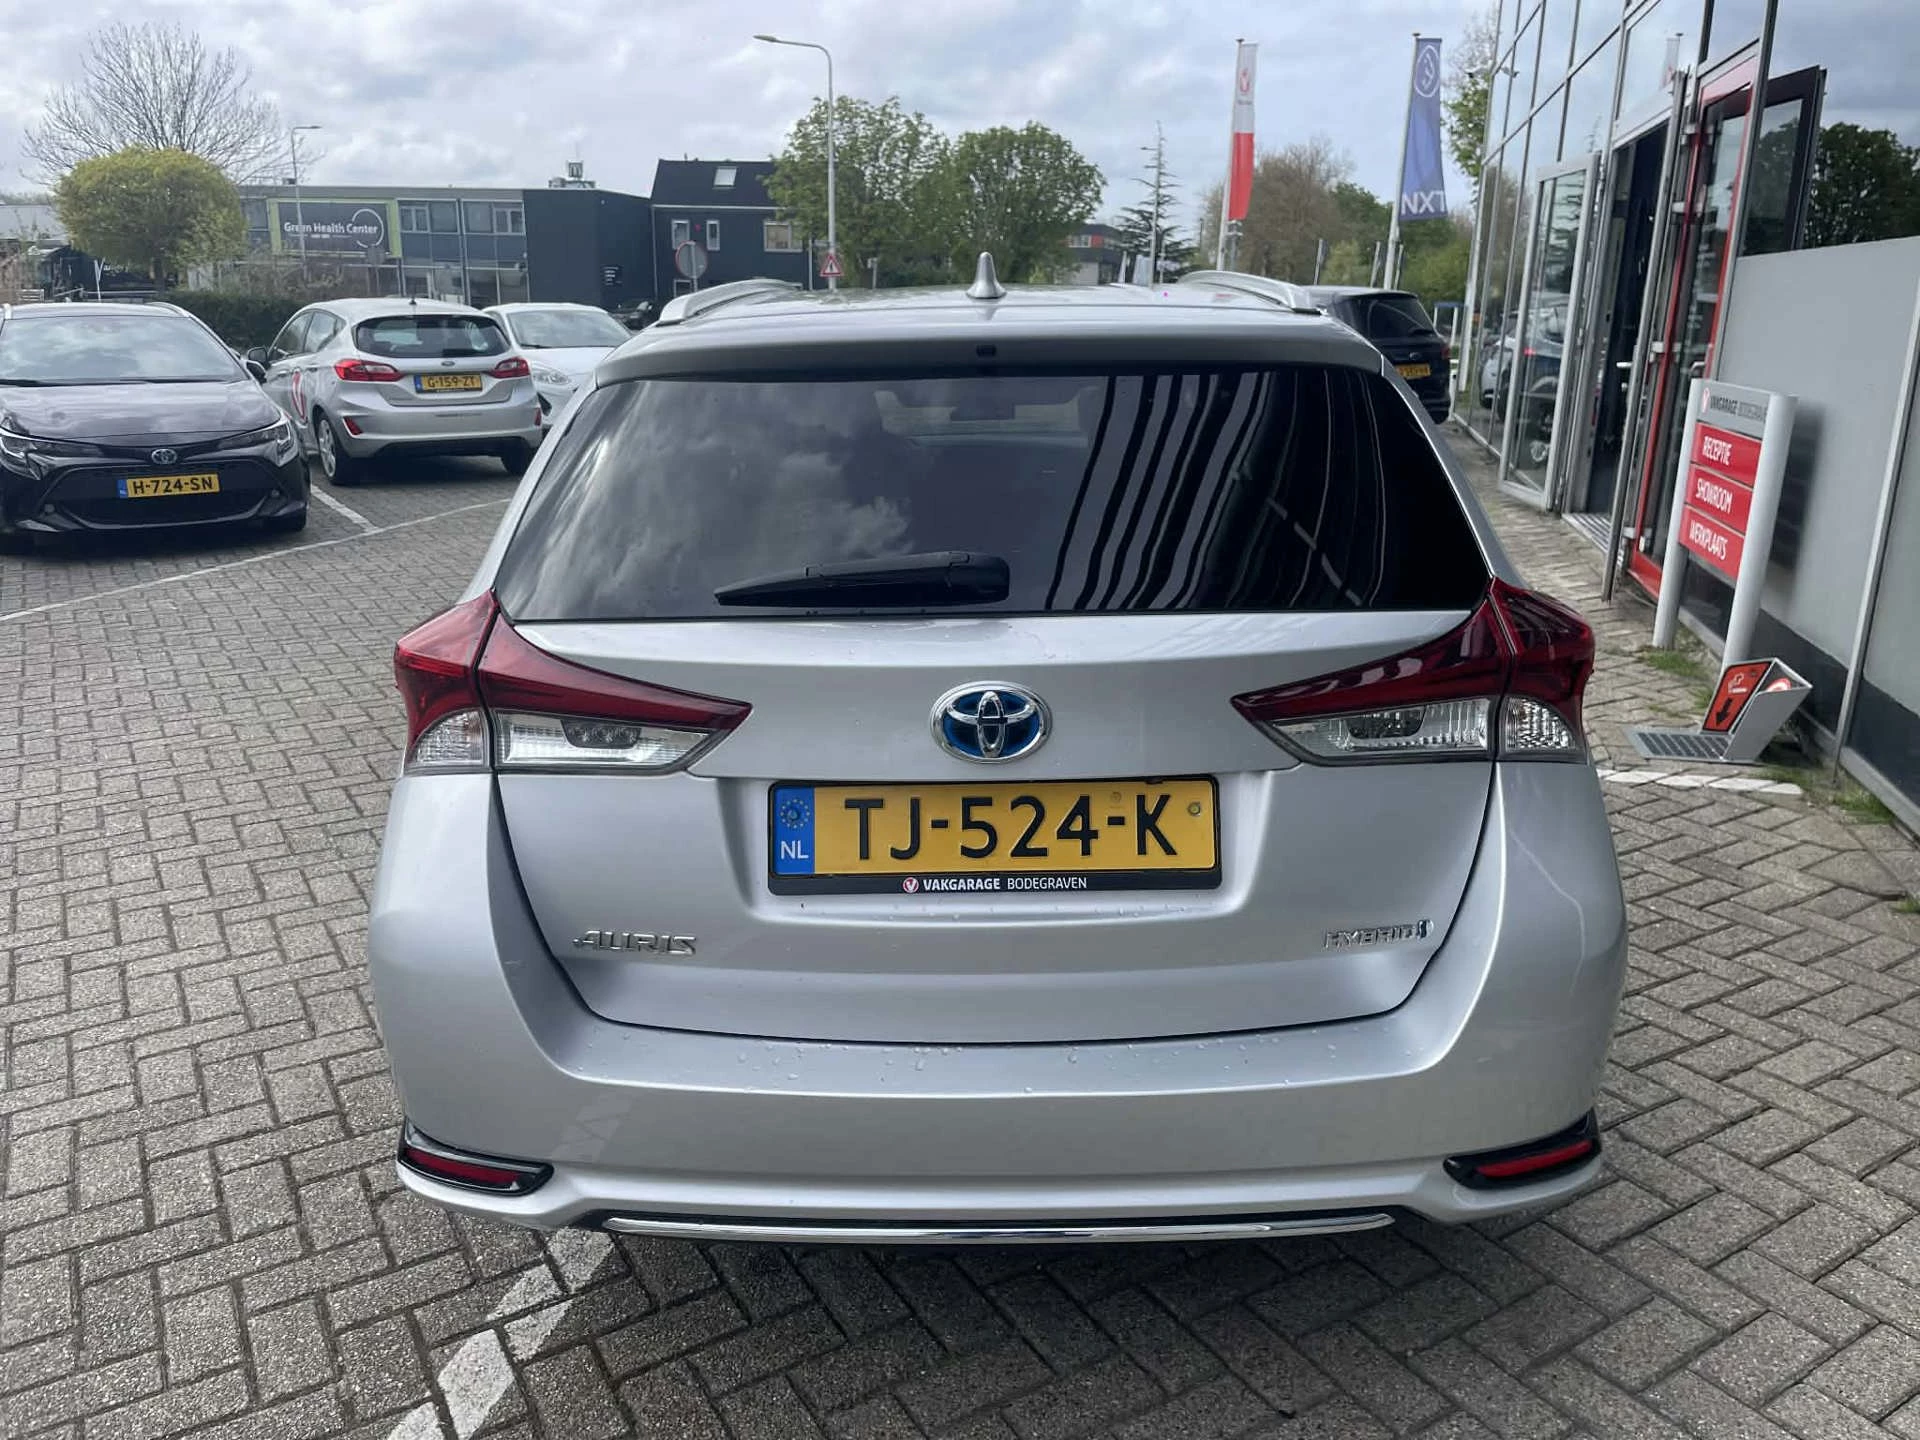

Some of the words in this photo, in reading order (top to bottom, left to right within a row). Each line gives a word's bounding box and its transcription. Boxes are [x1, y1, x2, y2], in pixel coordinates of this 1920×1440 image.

[1401, 190, 1446, 215] NXT
[313, 222, 345, 234] Health
[346, 223, 378, 235] Center
[1702, 436, 1732, 466] RECEPTIE
[132, 476, 213, 495] H-724-SN
[1696, 478, 1733, 514] SHOWROOM
[1689, 519, 1728, 561] WERKPLAATS
[844, 794, 1178, 861] TJ-524-K
[780, 840, 809, 861] NL
[923, 878, 1000, 891] VAKGARAGE
[1007, 877, 1087, 890] BODEGRAVEN
[573, 930, 697, 955] AURIS
[1323, 923, 1416, 948] HYBRID
